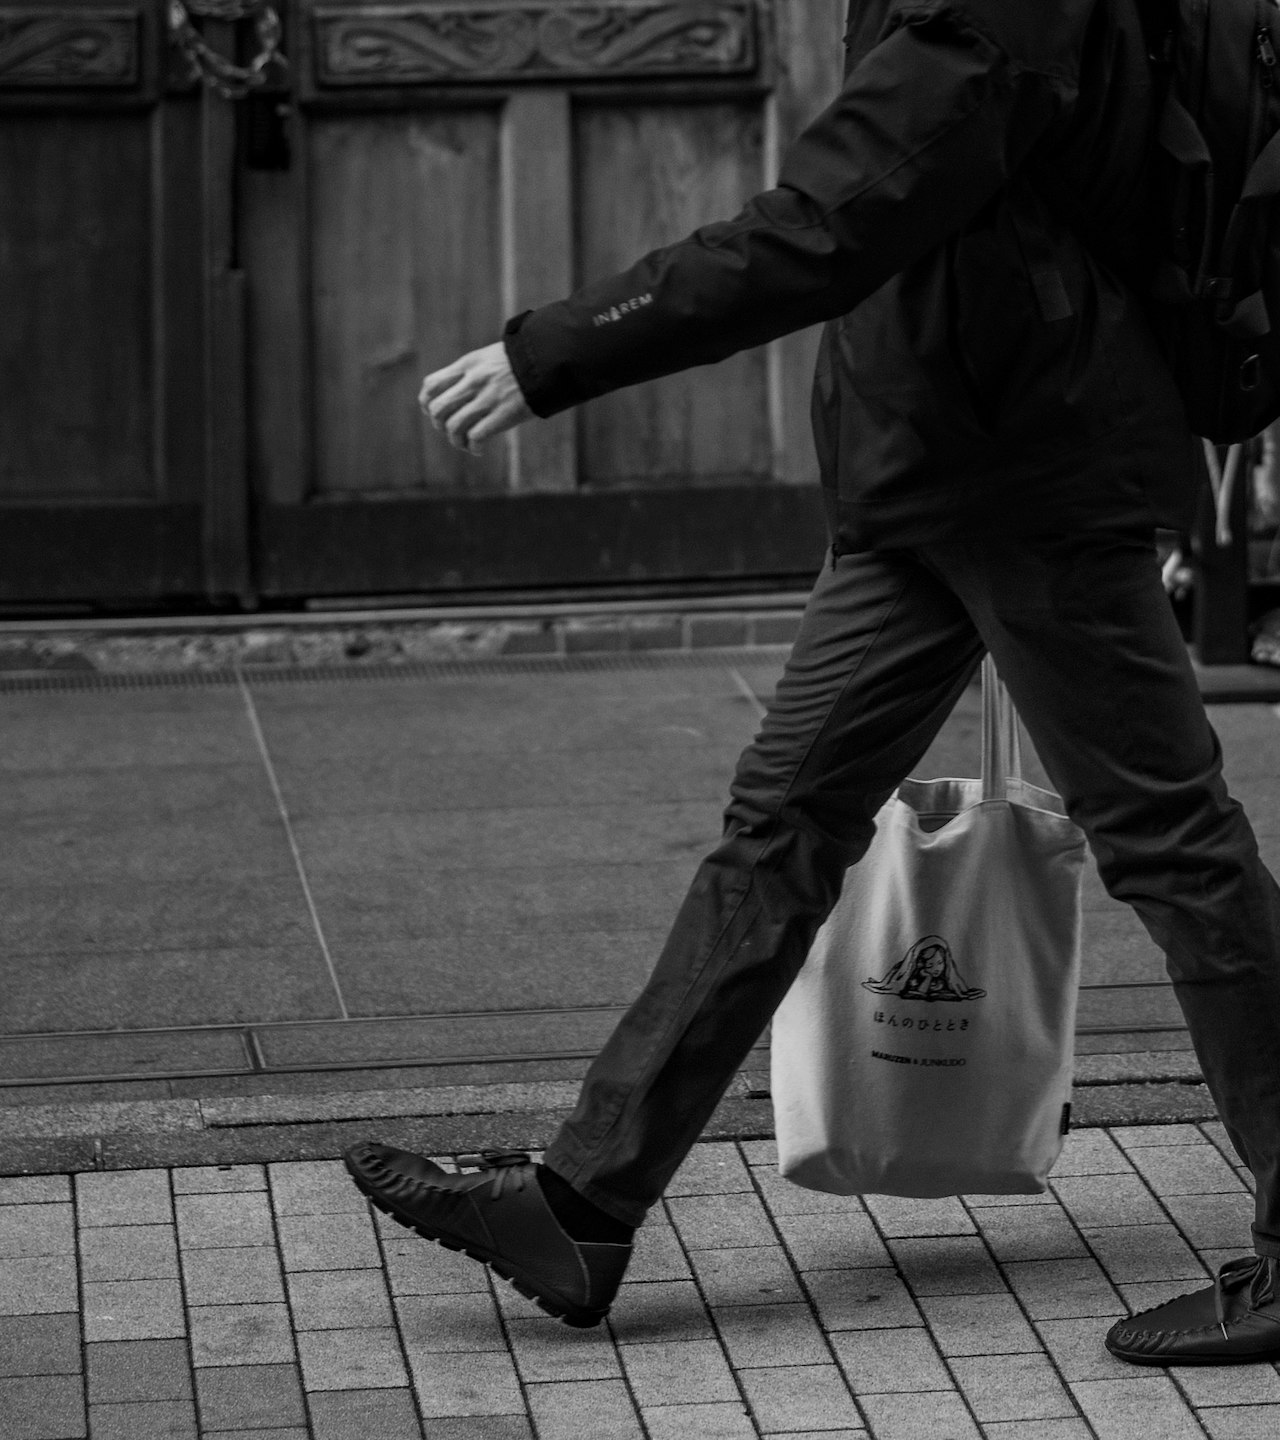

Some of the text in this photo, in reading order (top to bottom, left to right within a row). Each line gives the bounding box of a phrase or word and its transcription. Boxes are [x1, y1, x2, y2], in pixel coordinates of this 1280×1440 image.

[873, 1011, 970, 1032] ほんのひととき
